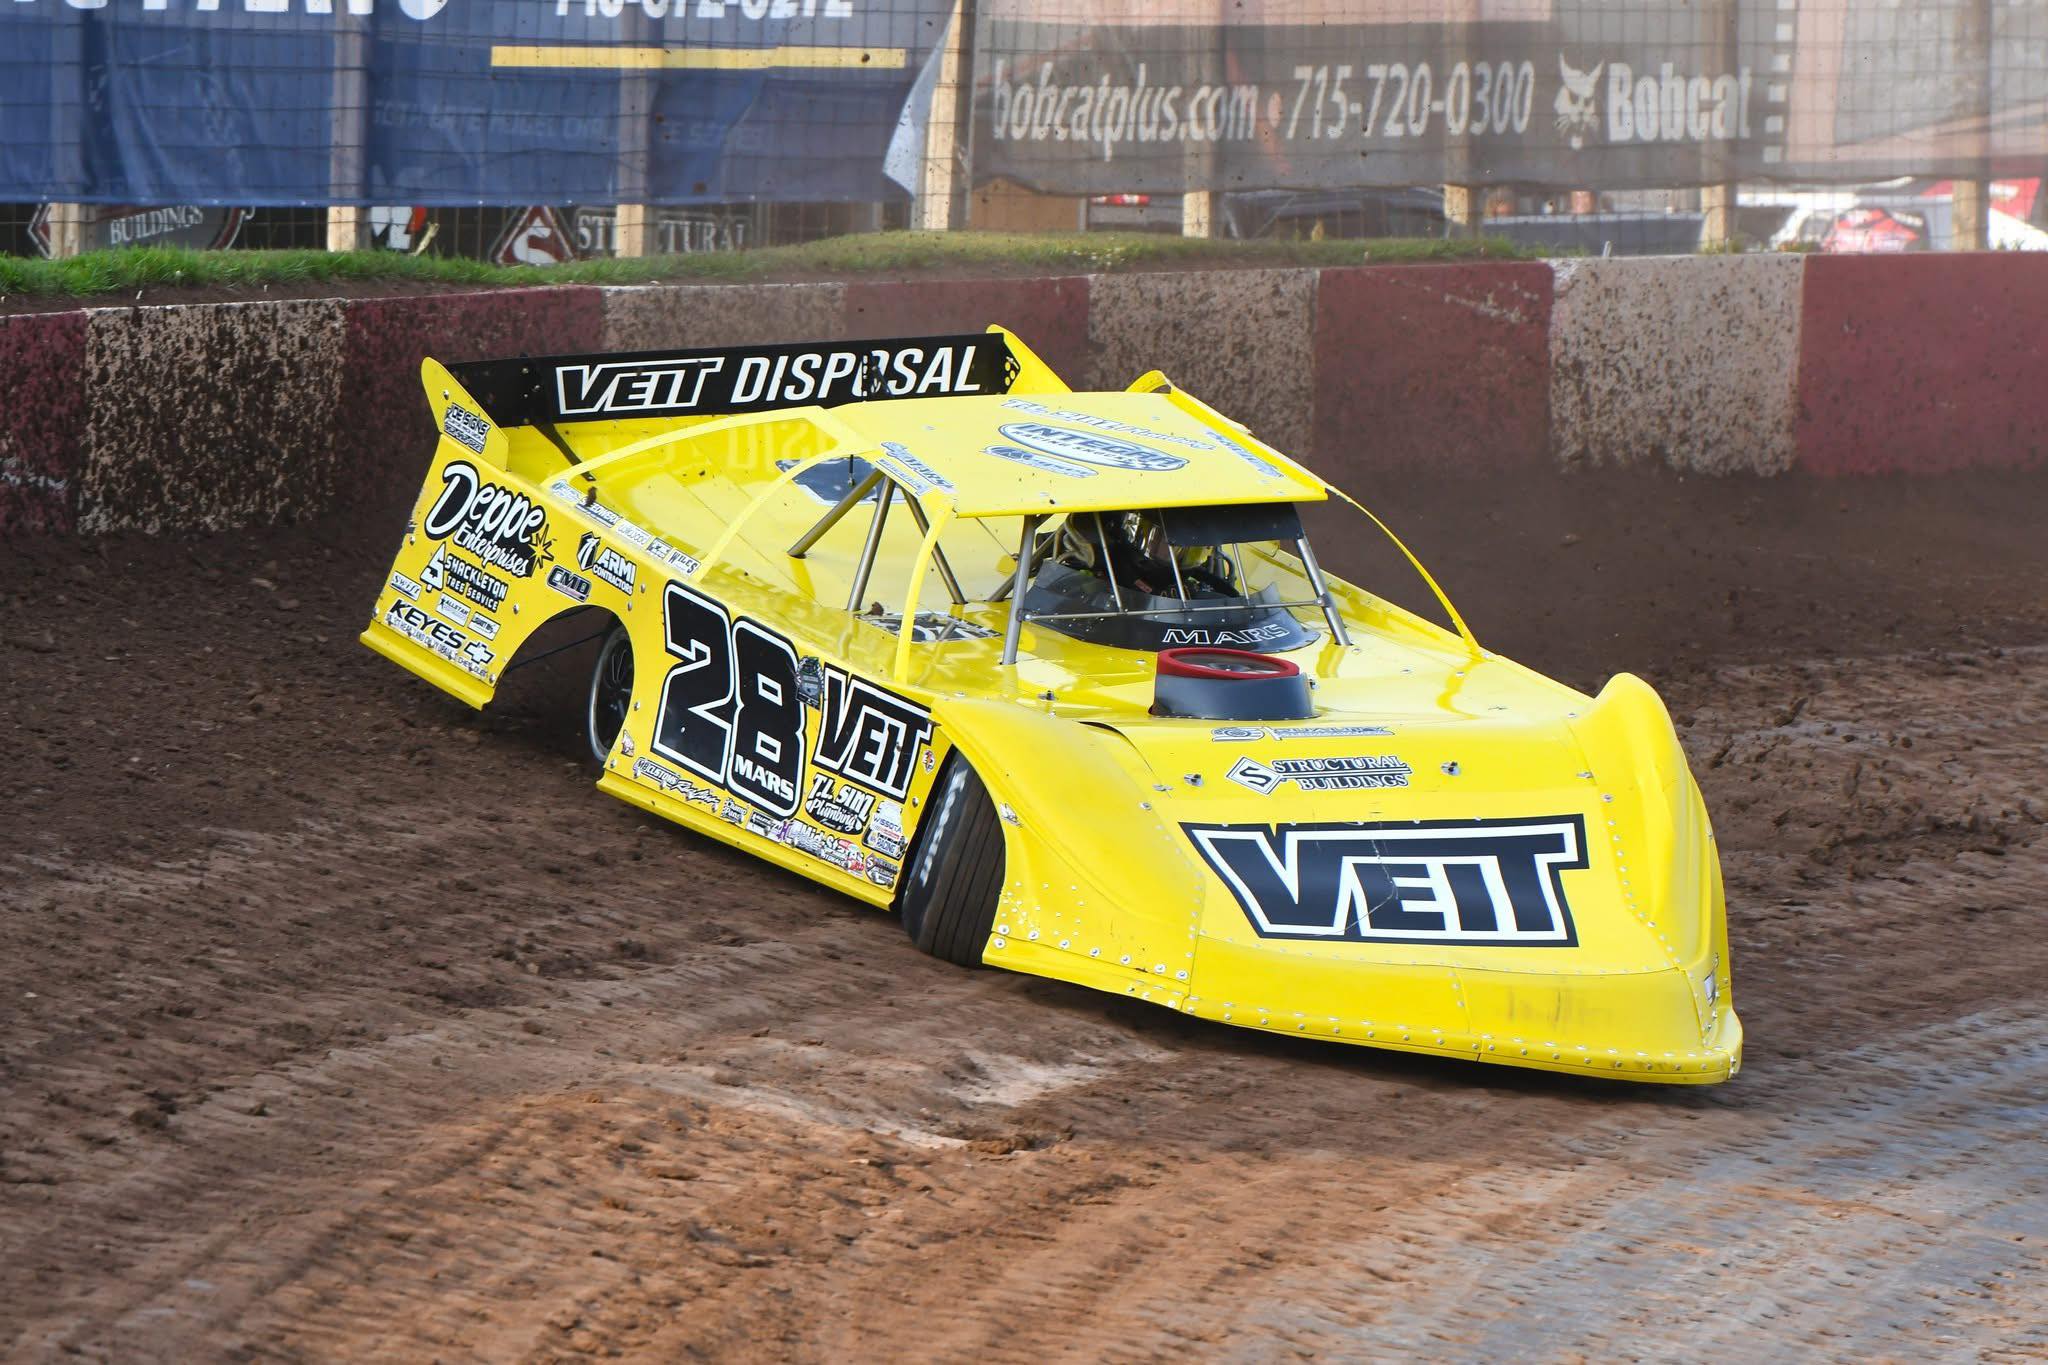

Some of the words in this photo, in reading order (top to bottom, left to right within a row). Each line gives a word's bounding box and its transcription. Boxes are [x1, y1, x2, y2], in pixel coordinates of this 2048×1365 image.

[993, 60, 1258, 163] bobcatplus.com
[1287, 60, 1536, 141] 715-720-0300
[1607, 62, 1753, 143] Bobcat
[110, 205, 204, 245] BUILDINGS
[555, 356, 726, 415] VEIT
[730, 345, 982, 404] DISPOSAL
[1015, 423, 1184, 469] INTEGRA
[425, 461, 546, 544] Deppe
[453, 520, 529, 577] Enterprises
[668, 551, 698, 575] WILES
[444, 554, 509, 602] SHACKLETON
[446, 574, 467, 596] TREE
[466, 585, 500, 613] SERVICE
[592, 563, 633, 596] CONTRACTORS
[389, 599, 467, 650] KEYES
[1162, 623, 1290, 645] MARS
[651, 579, 806, 818] 28
[812, 663, 934, 801] VEIT
[734, 753, 794, 802] MARS
[808, 773, 834, 800] T.L.
[1272, 755, 1407, 774] STRUCTURAL
[1300, 773, 1408, 790] BUILDINGS
[809, 798, 858, 832] Plumbing
[1186, 817, 1585, 945] VEIT
